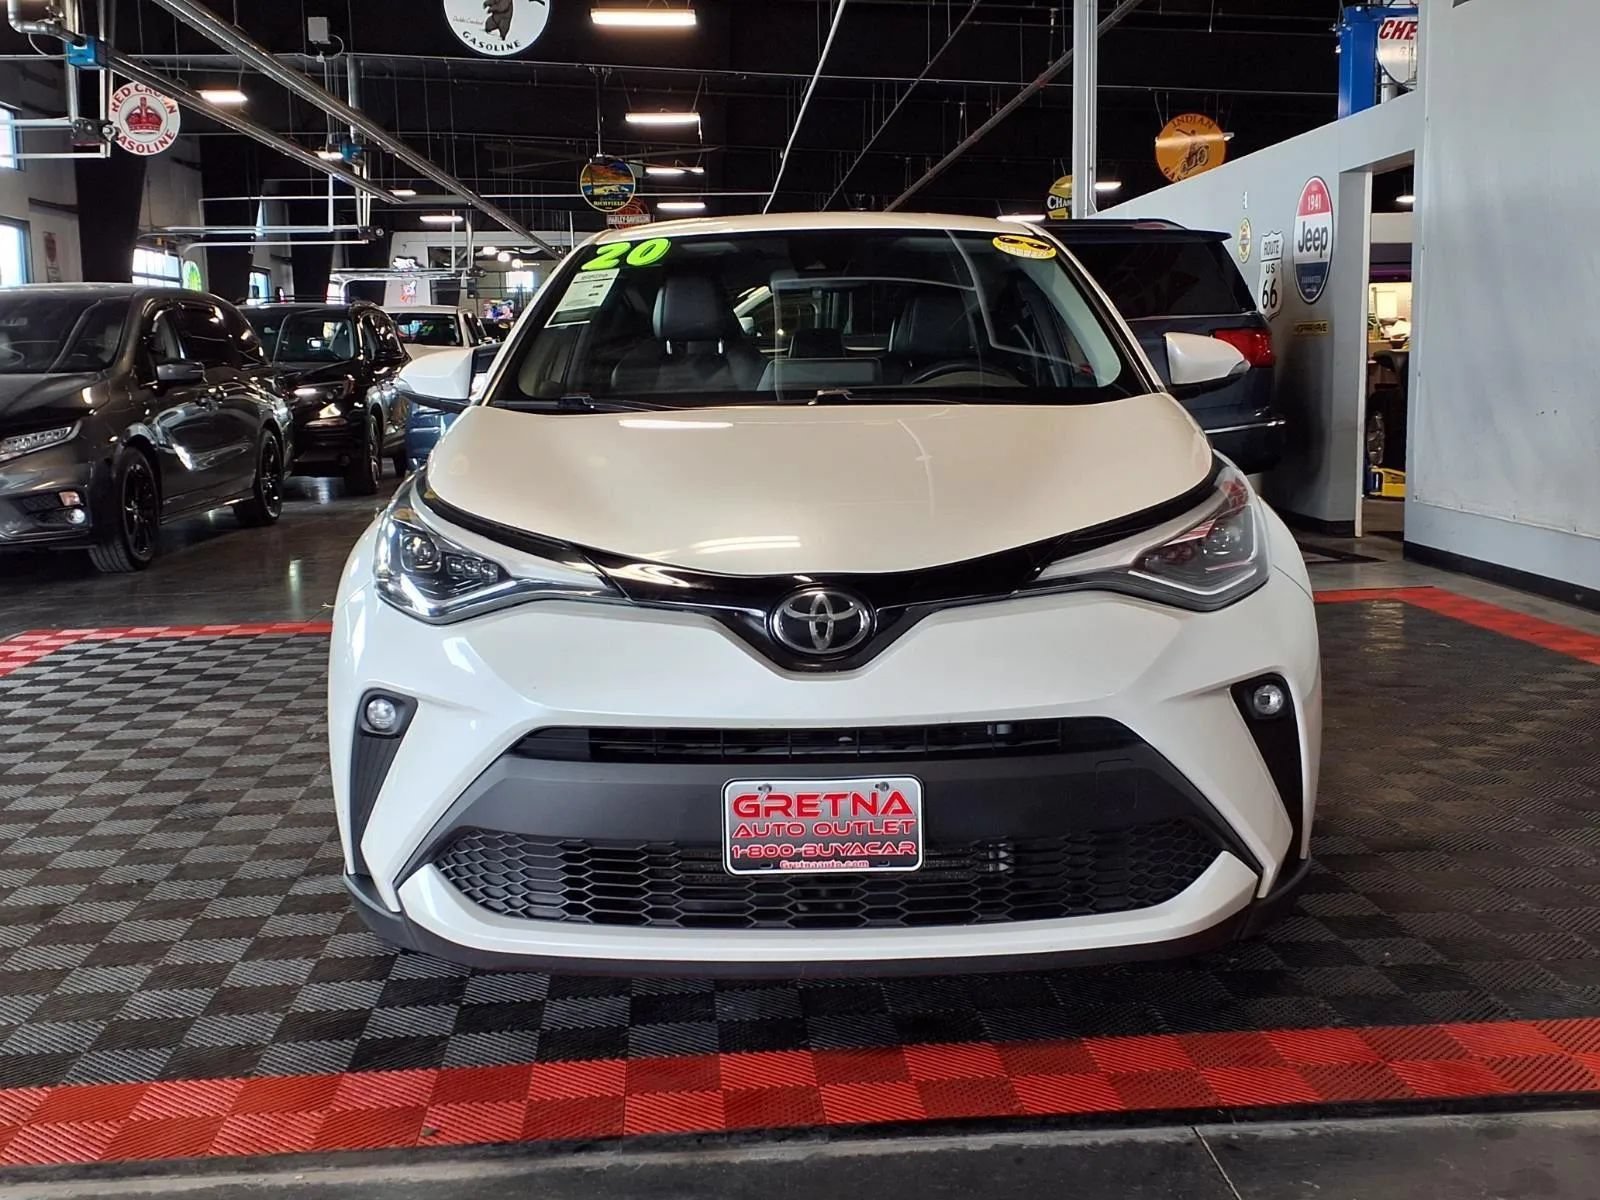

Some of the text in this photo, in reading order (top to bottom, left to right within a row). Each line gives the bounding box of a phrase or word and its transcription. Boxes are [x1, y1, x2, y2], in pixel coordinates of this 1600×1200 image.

[462, 31, 521, 52] GASOLINE
[112, 83, 177, 114] RED CRON
[1171, 115, 1216, 130] INDIAN
[1307, 194, 1322, 211] 1941
[1263, 239, 1280, 256] ROUTE
[1298, 221, 1328, 258] Jeep
[581, 238, 671, 270] 20
[1265, 262, 1276, 274] US
[1261, 278, 1278, 310] 66
[732, 791, 915, 819] GRETNA
[732, 819, 916, 838] AUTO OUTLET
[731, 841, 917, 859] 1-800-BUYACAR
